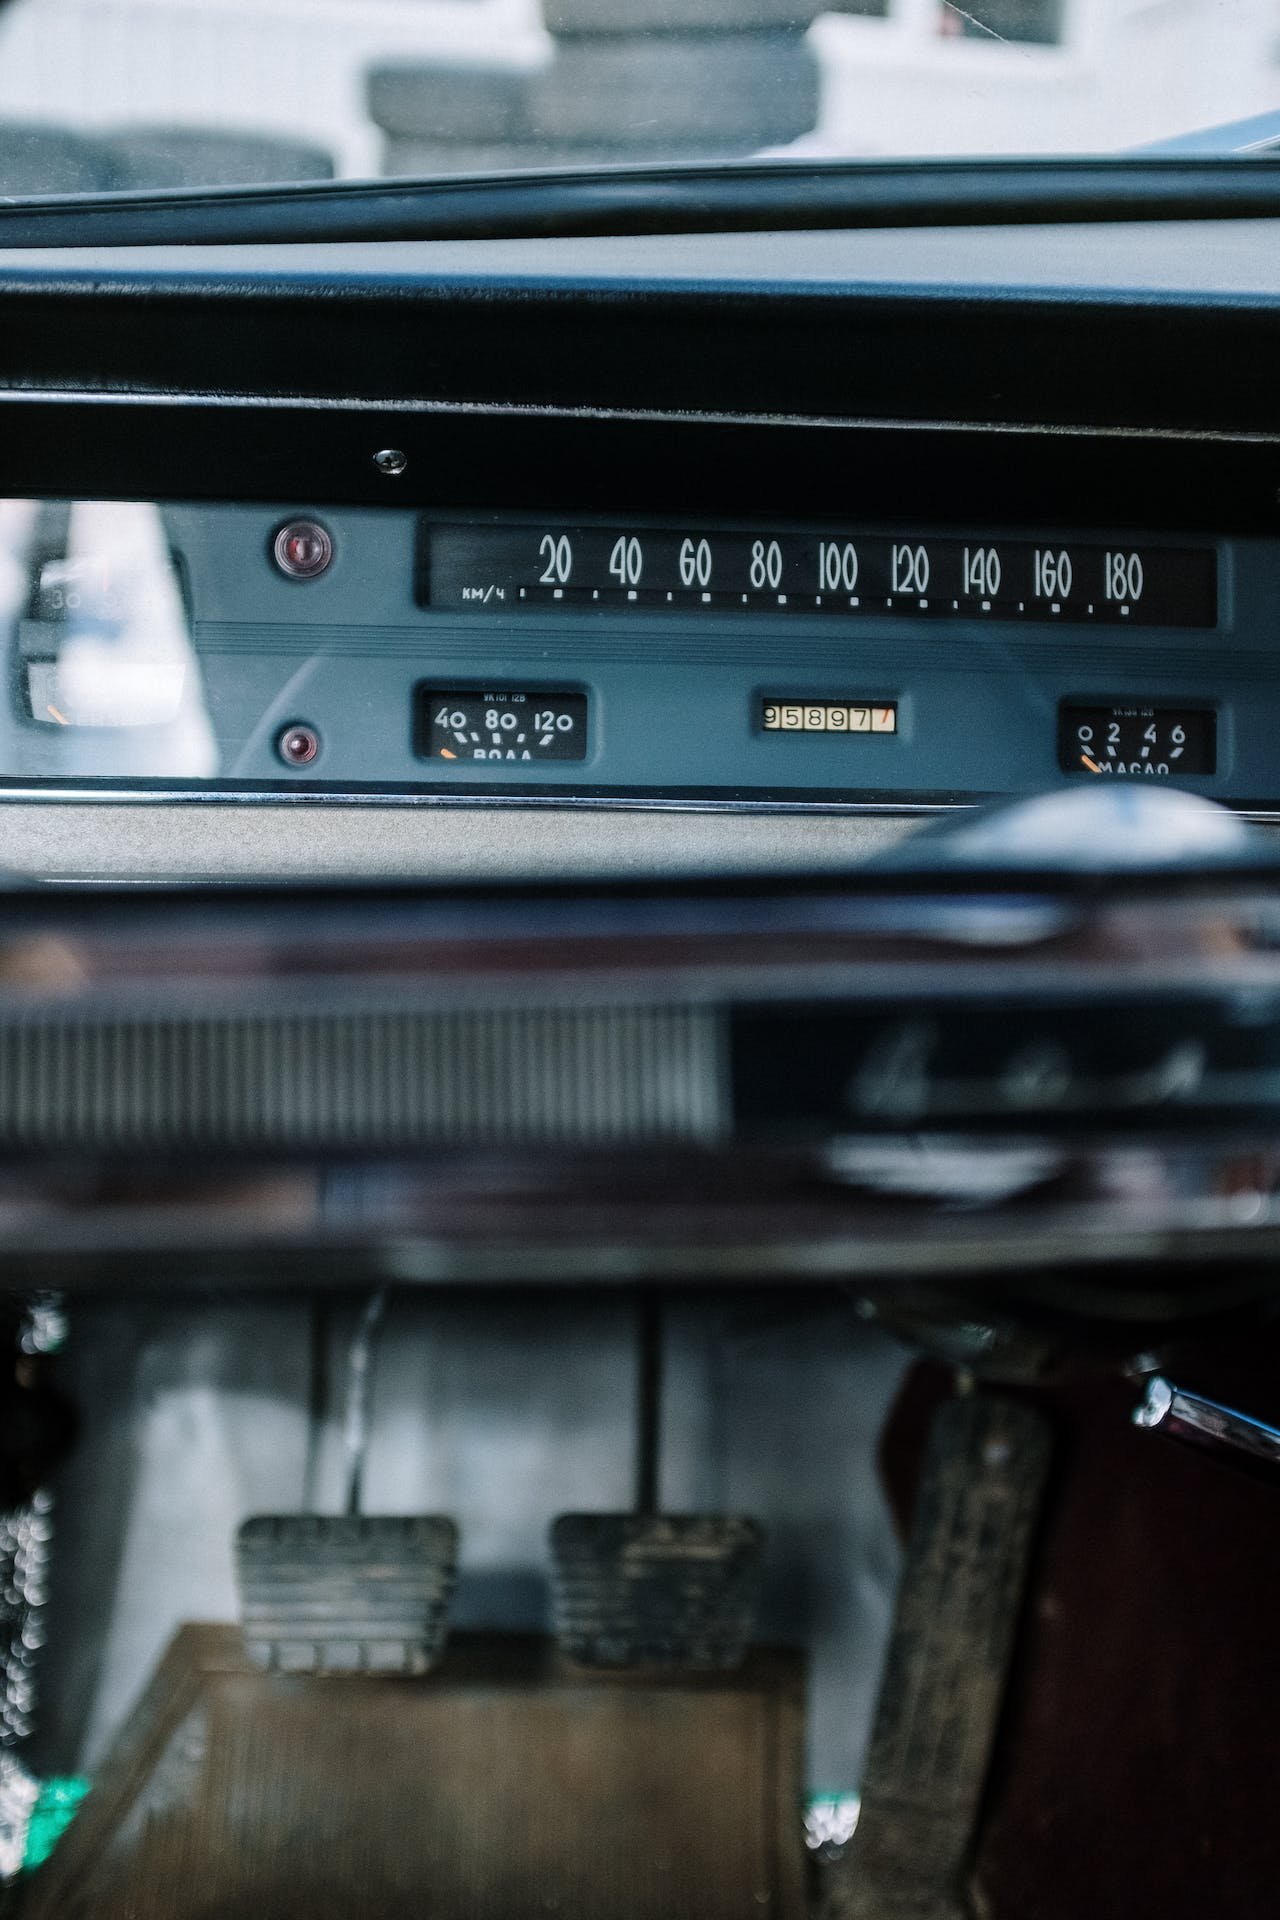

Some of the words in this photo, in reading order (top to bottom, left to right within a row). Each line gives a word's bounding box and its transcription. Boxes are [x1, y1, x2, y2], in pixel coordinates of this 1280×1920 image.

[539, 535, 572, 583] 20
[609, 536, 643, 584] 40
[679, 538, 712, 586] 60
[750, 540, 782, 588] 80
[819, 542, 859, 590] 100
[892, 544, 930, 592] 120
[964, 547, 1001, 595] 140
[1035, 550, 1073, 598] 160
[1106, 551, 1144, 600] 180
[434, 707, 467, 728] 40
[485, 709, 517, 730] 80
[534, 711, 573, 732] 120
[1108, 722, 1120, 742] 2
[1144, 723, 1157, 743] 4
[1171, 725, 1186, 744] 6
